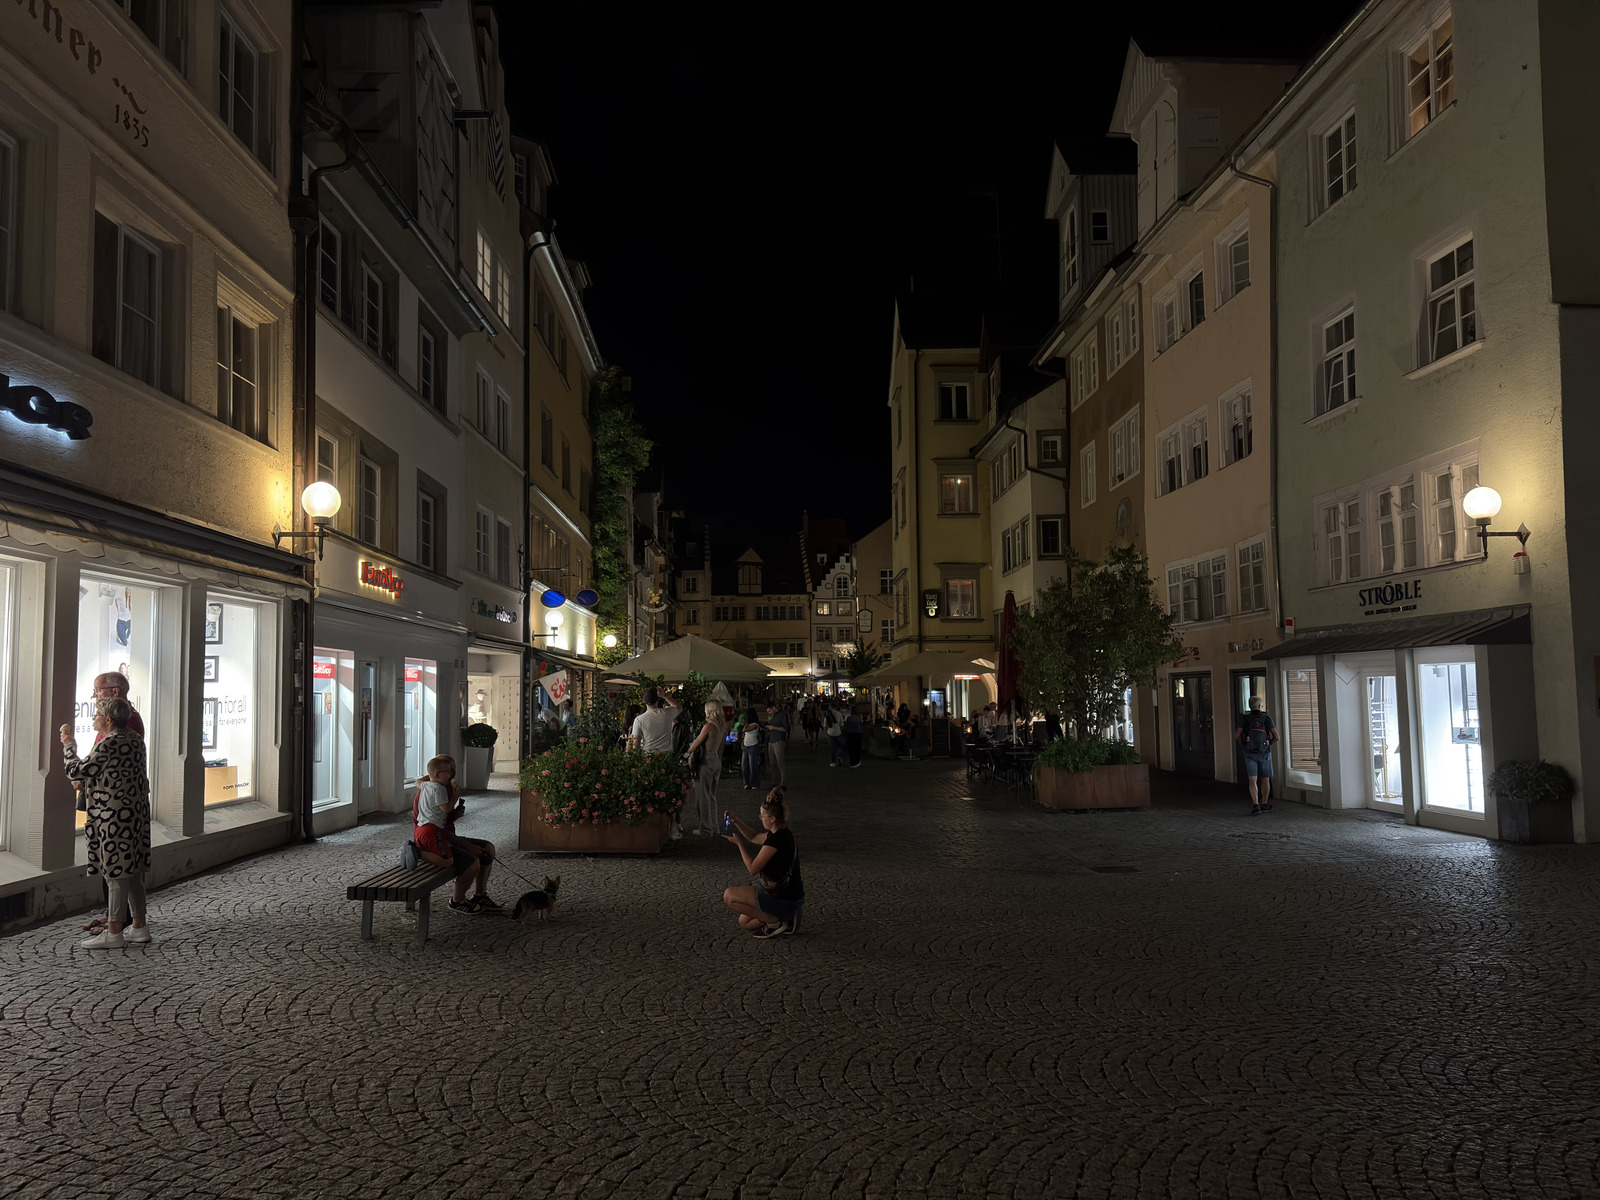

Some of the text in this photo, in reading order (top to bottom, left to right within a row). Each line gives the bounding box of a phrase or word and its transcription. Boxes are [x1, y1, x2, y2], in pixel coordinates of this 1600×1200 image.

[115, 104, 150, 147] 1835
[1359, 580, 1422, 606] STRÖBLE
[224, 695, 237, 714] for
